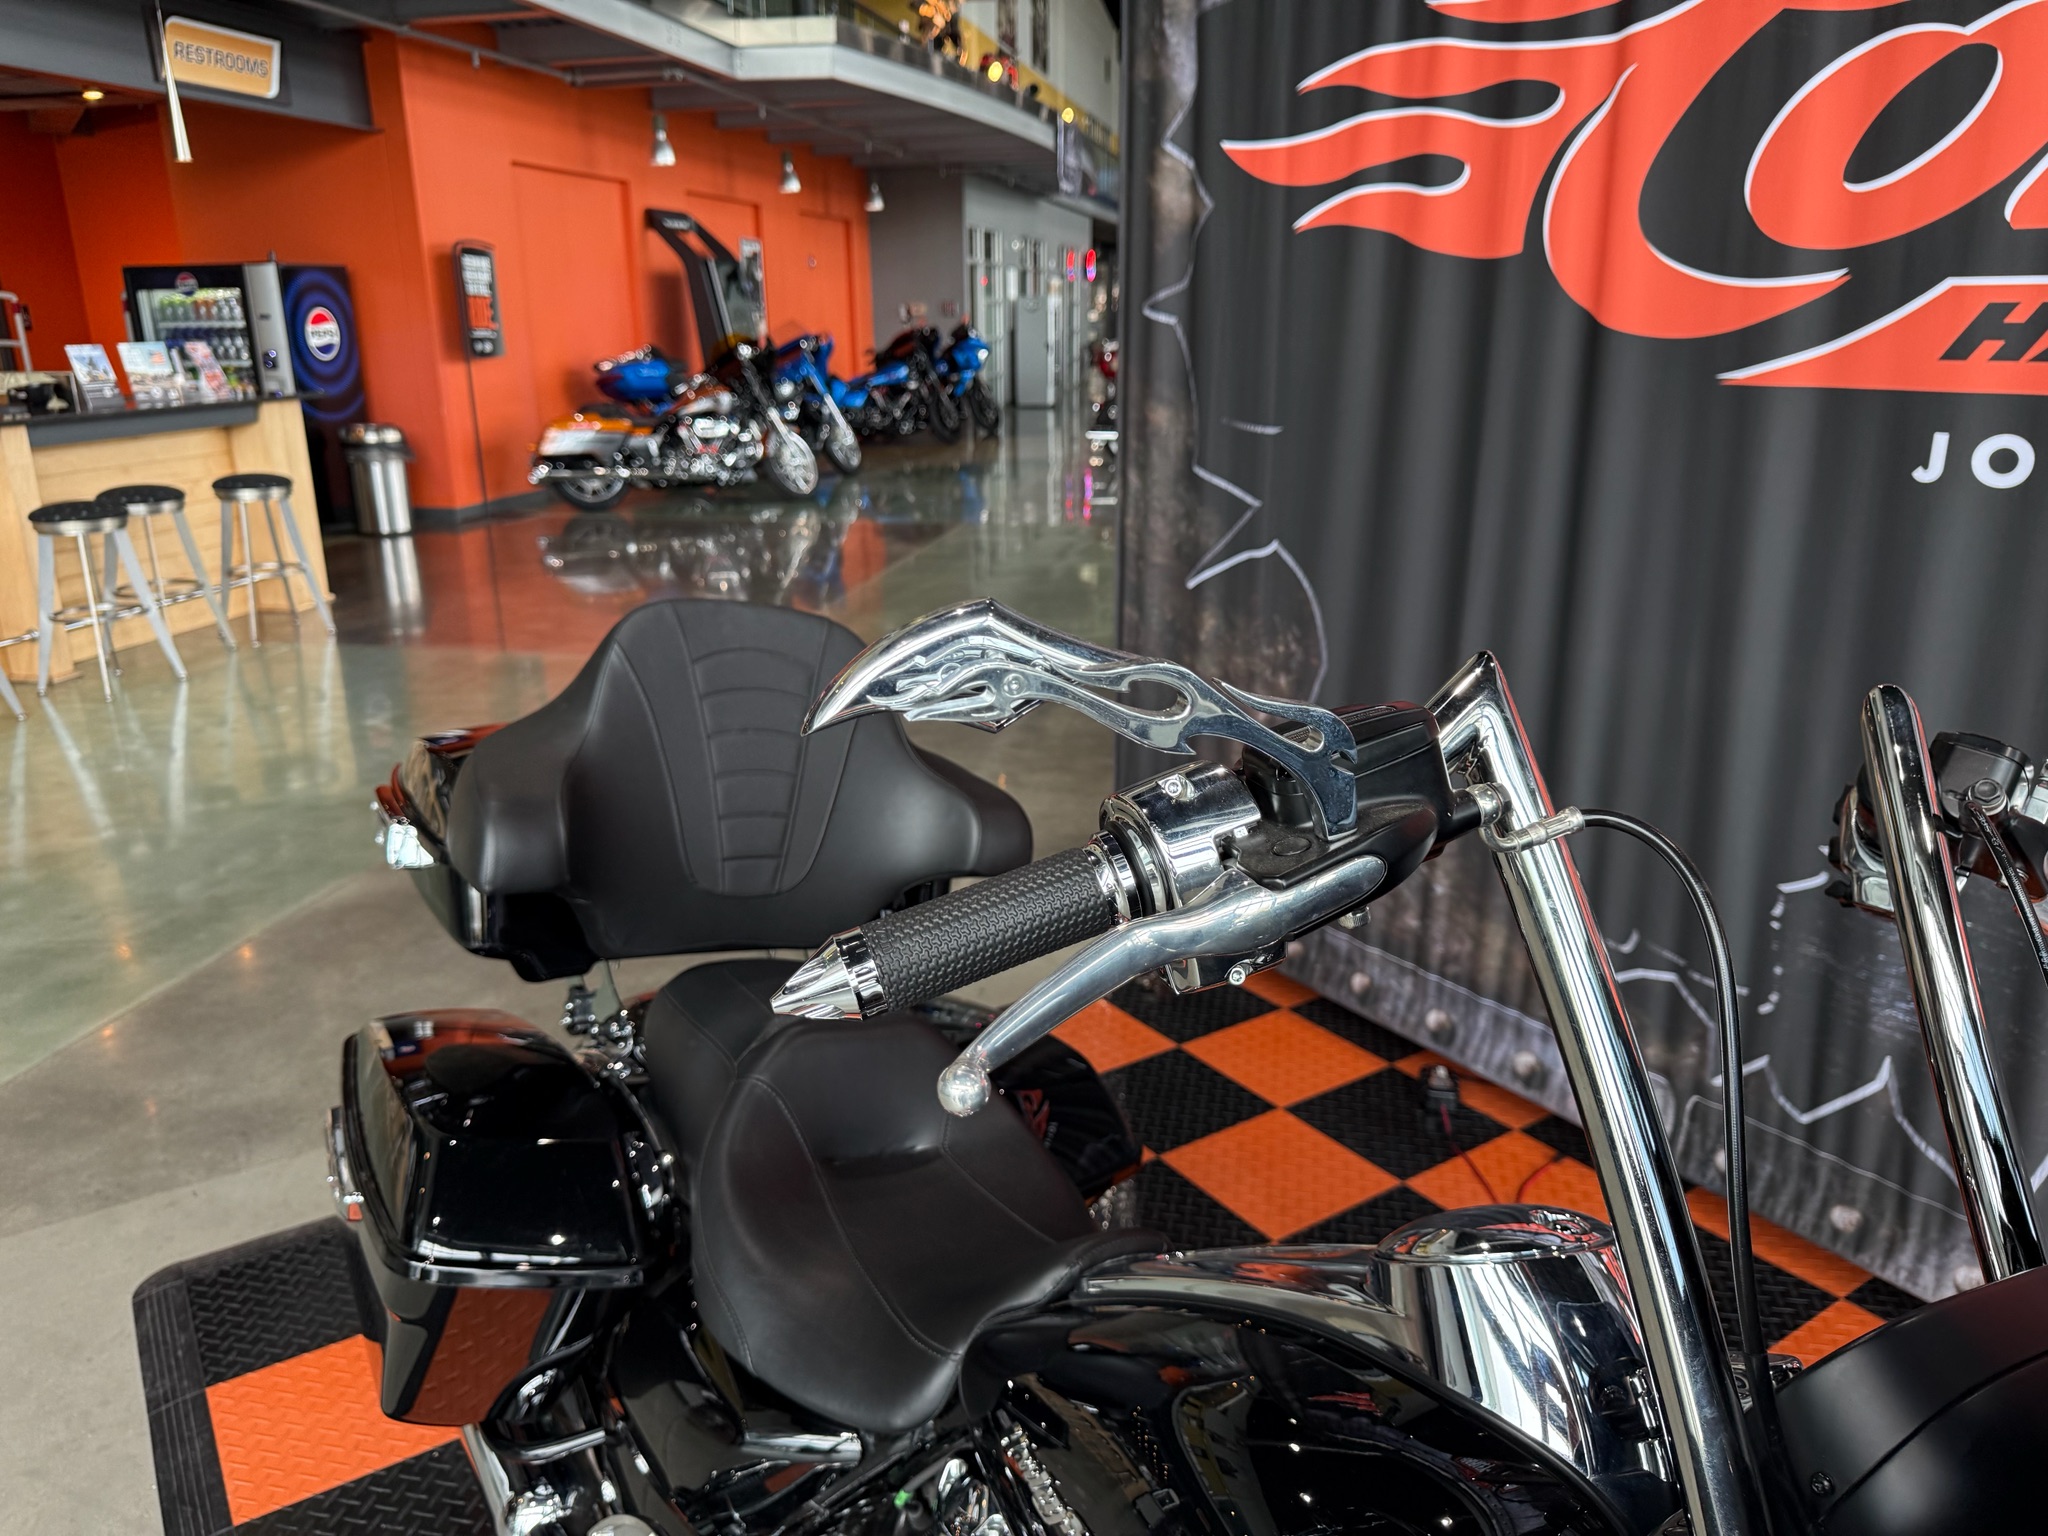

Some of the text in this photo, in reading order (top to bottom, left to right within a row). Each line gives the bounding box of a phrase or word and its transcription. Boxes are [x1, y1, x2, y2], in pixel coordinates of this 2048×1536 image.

[173, 40, 269, 78] RESTROOMS
[1220, 0, 2048, 338] Co
[1937, 302, 2048, 363] H
[1911, 431, 2036, 489] JO
